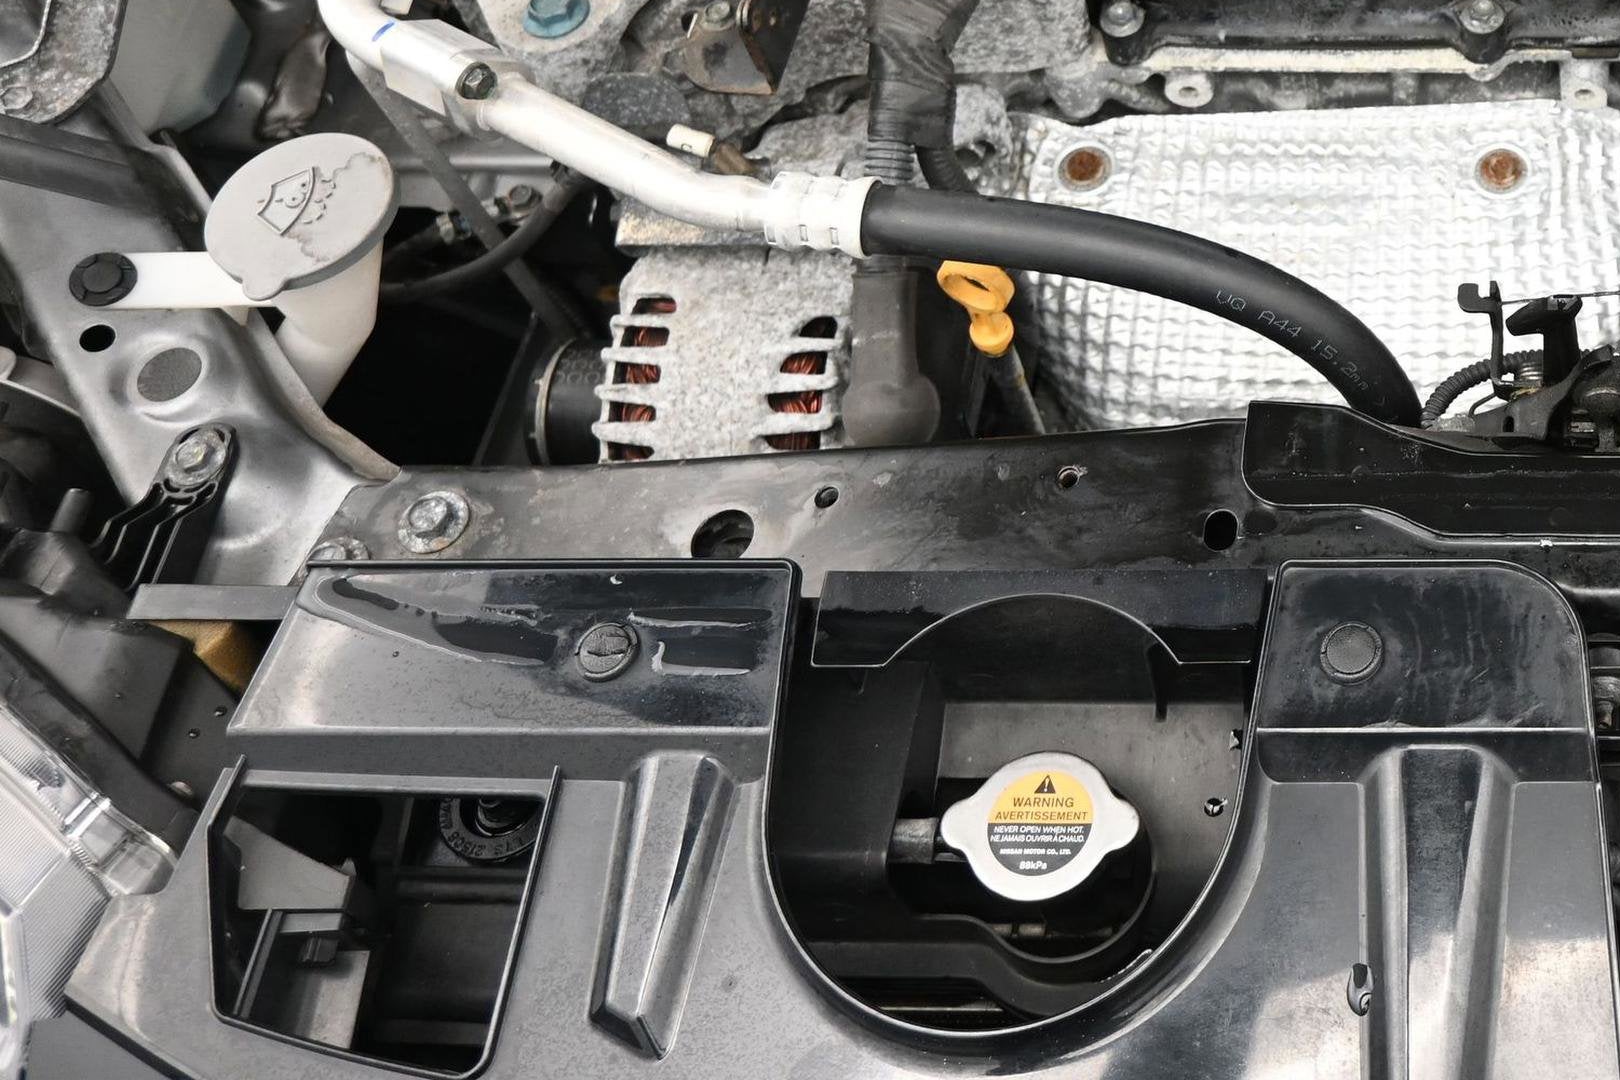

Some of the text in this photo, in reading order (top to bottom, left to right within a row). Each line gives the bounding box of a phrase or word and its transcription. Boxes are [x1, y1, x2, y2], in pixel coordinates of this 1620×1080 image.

[1257, 310, 1303, 338] A44
[1310, 339, 1370, 391] 15.2mm
[1012, 796, 1075, 808] WARNING
[994, 810, 1089, 821] AVERTISSEMENT
[993, 825, 1085, 834] NEVER OPEN WHEN HOT.
[990, 834, 1001, 843] NE
[1001, 834, 1026, 843] JAMAIS
[1025, 834, 1052, 843] OUVRIR
[1000, 848, 1023, 856] NISSAN
[1023, 848, 1047, 856] MOTOR
